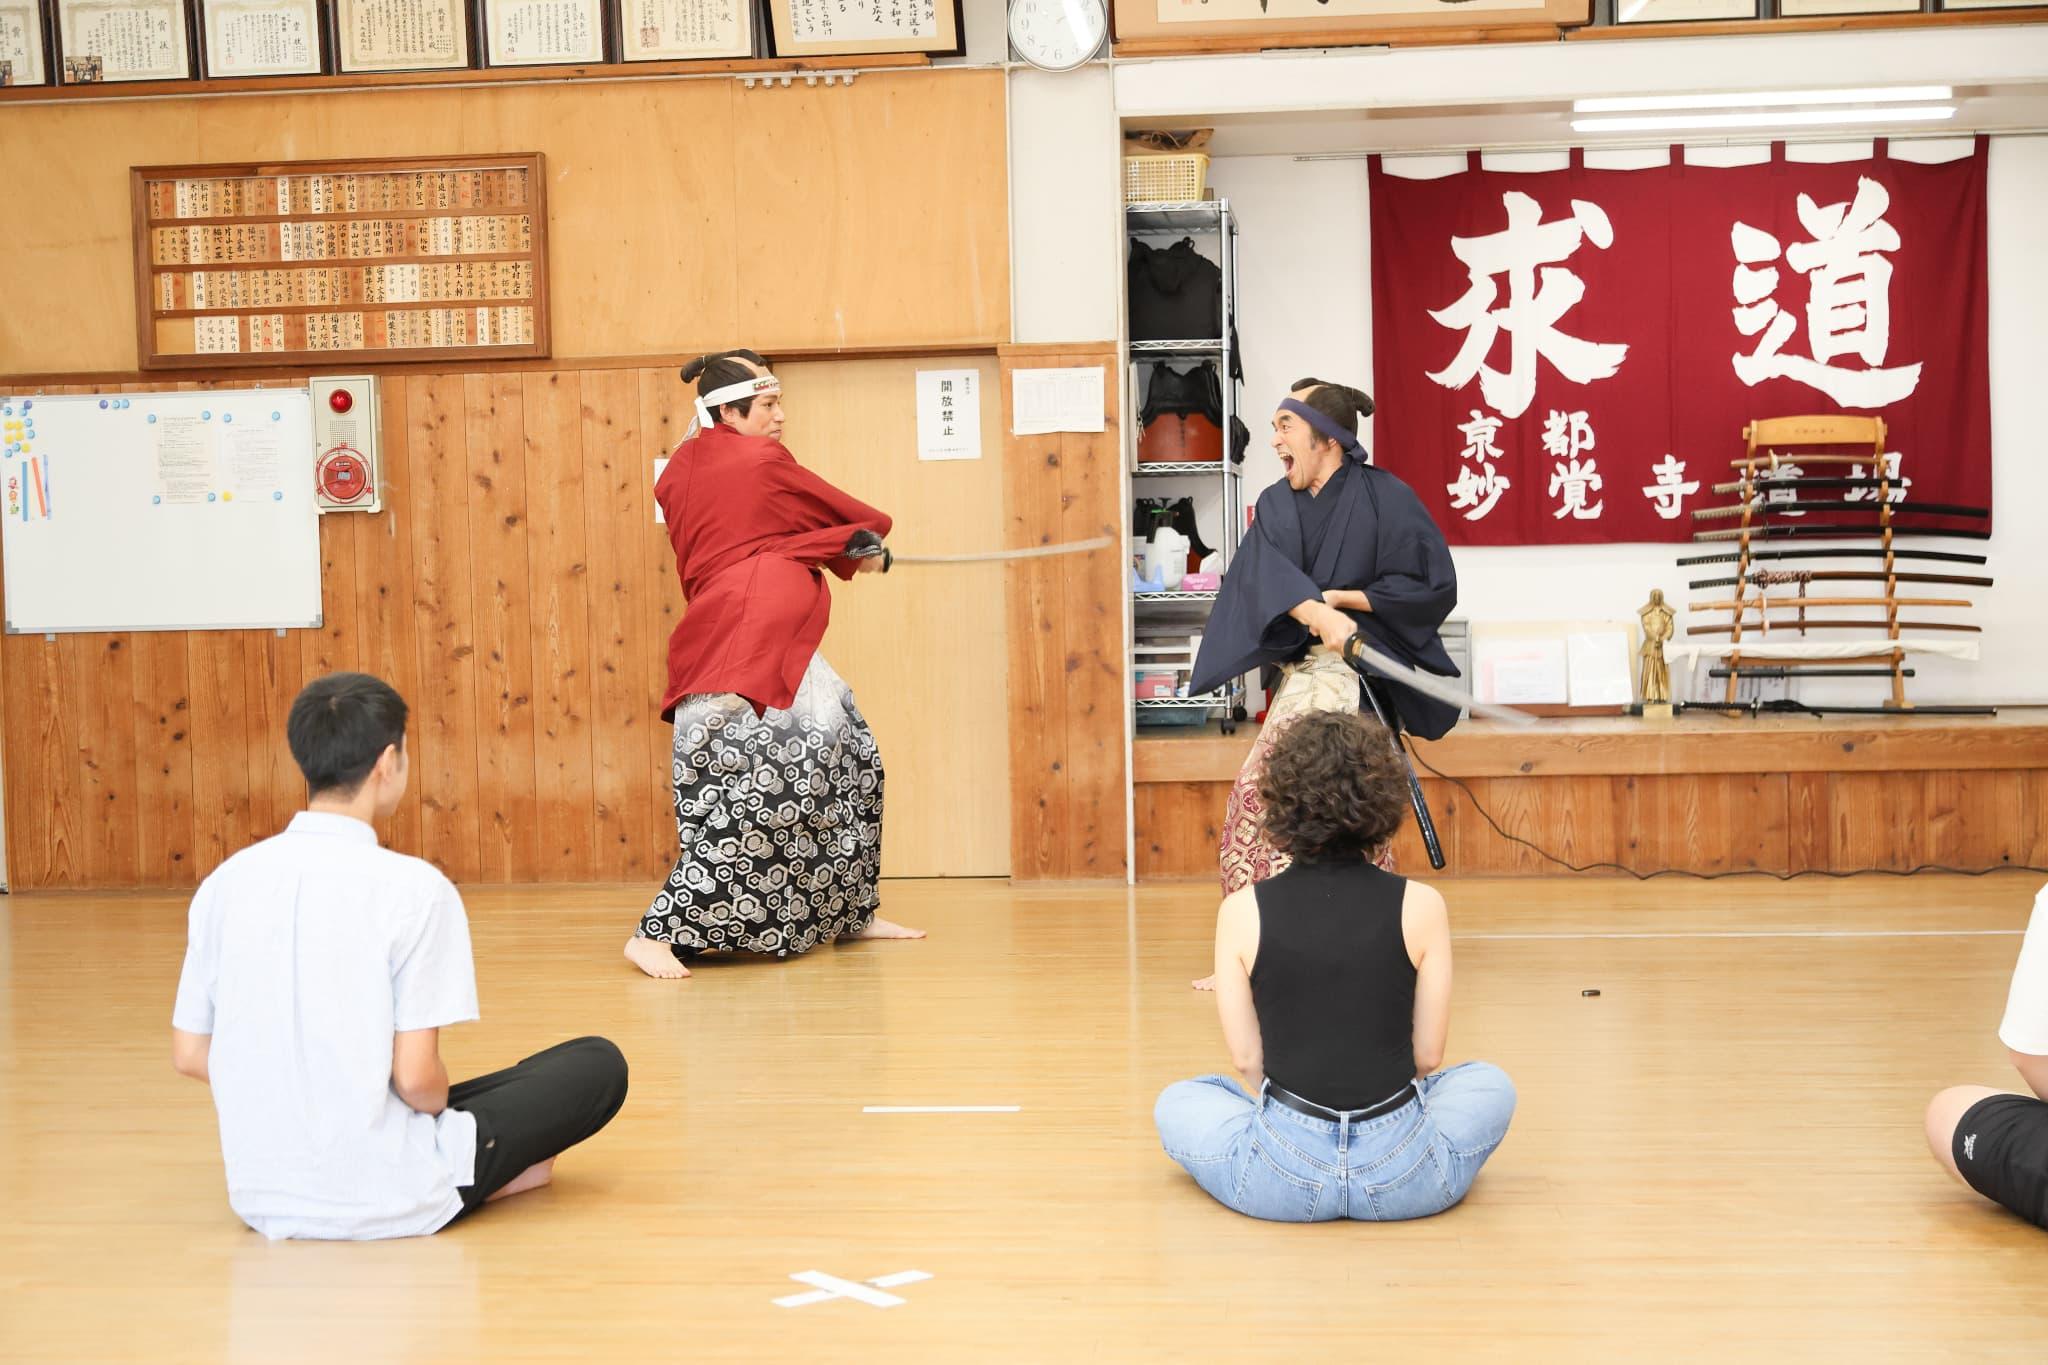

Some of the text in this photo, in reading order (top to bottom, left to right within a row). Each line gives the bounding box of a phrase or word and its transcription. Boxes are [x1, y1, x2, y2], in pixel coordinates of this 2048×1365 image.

[940, 379, 955, 436] 開放禁止
[1457, 409, 1596, 463] 京都
